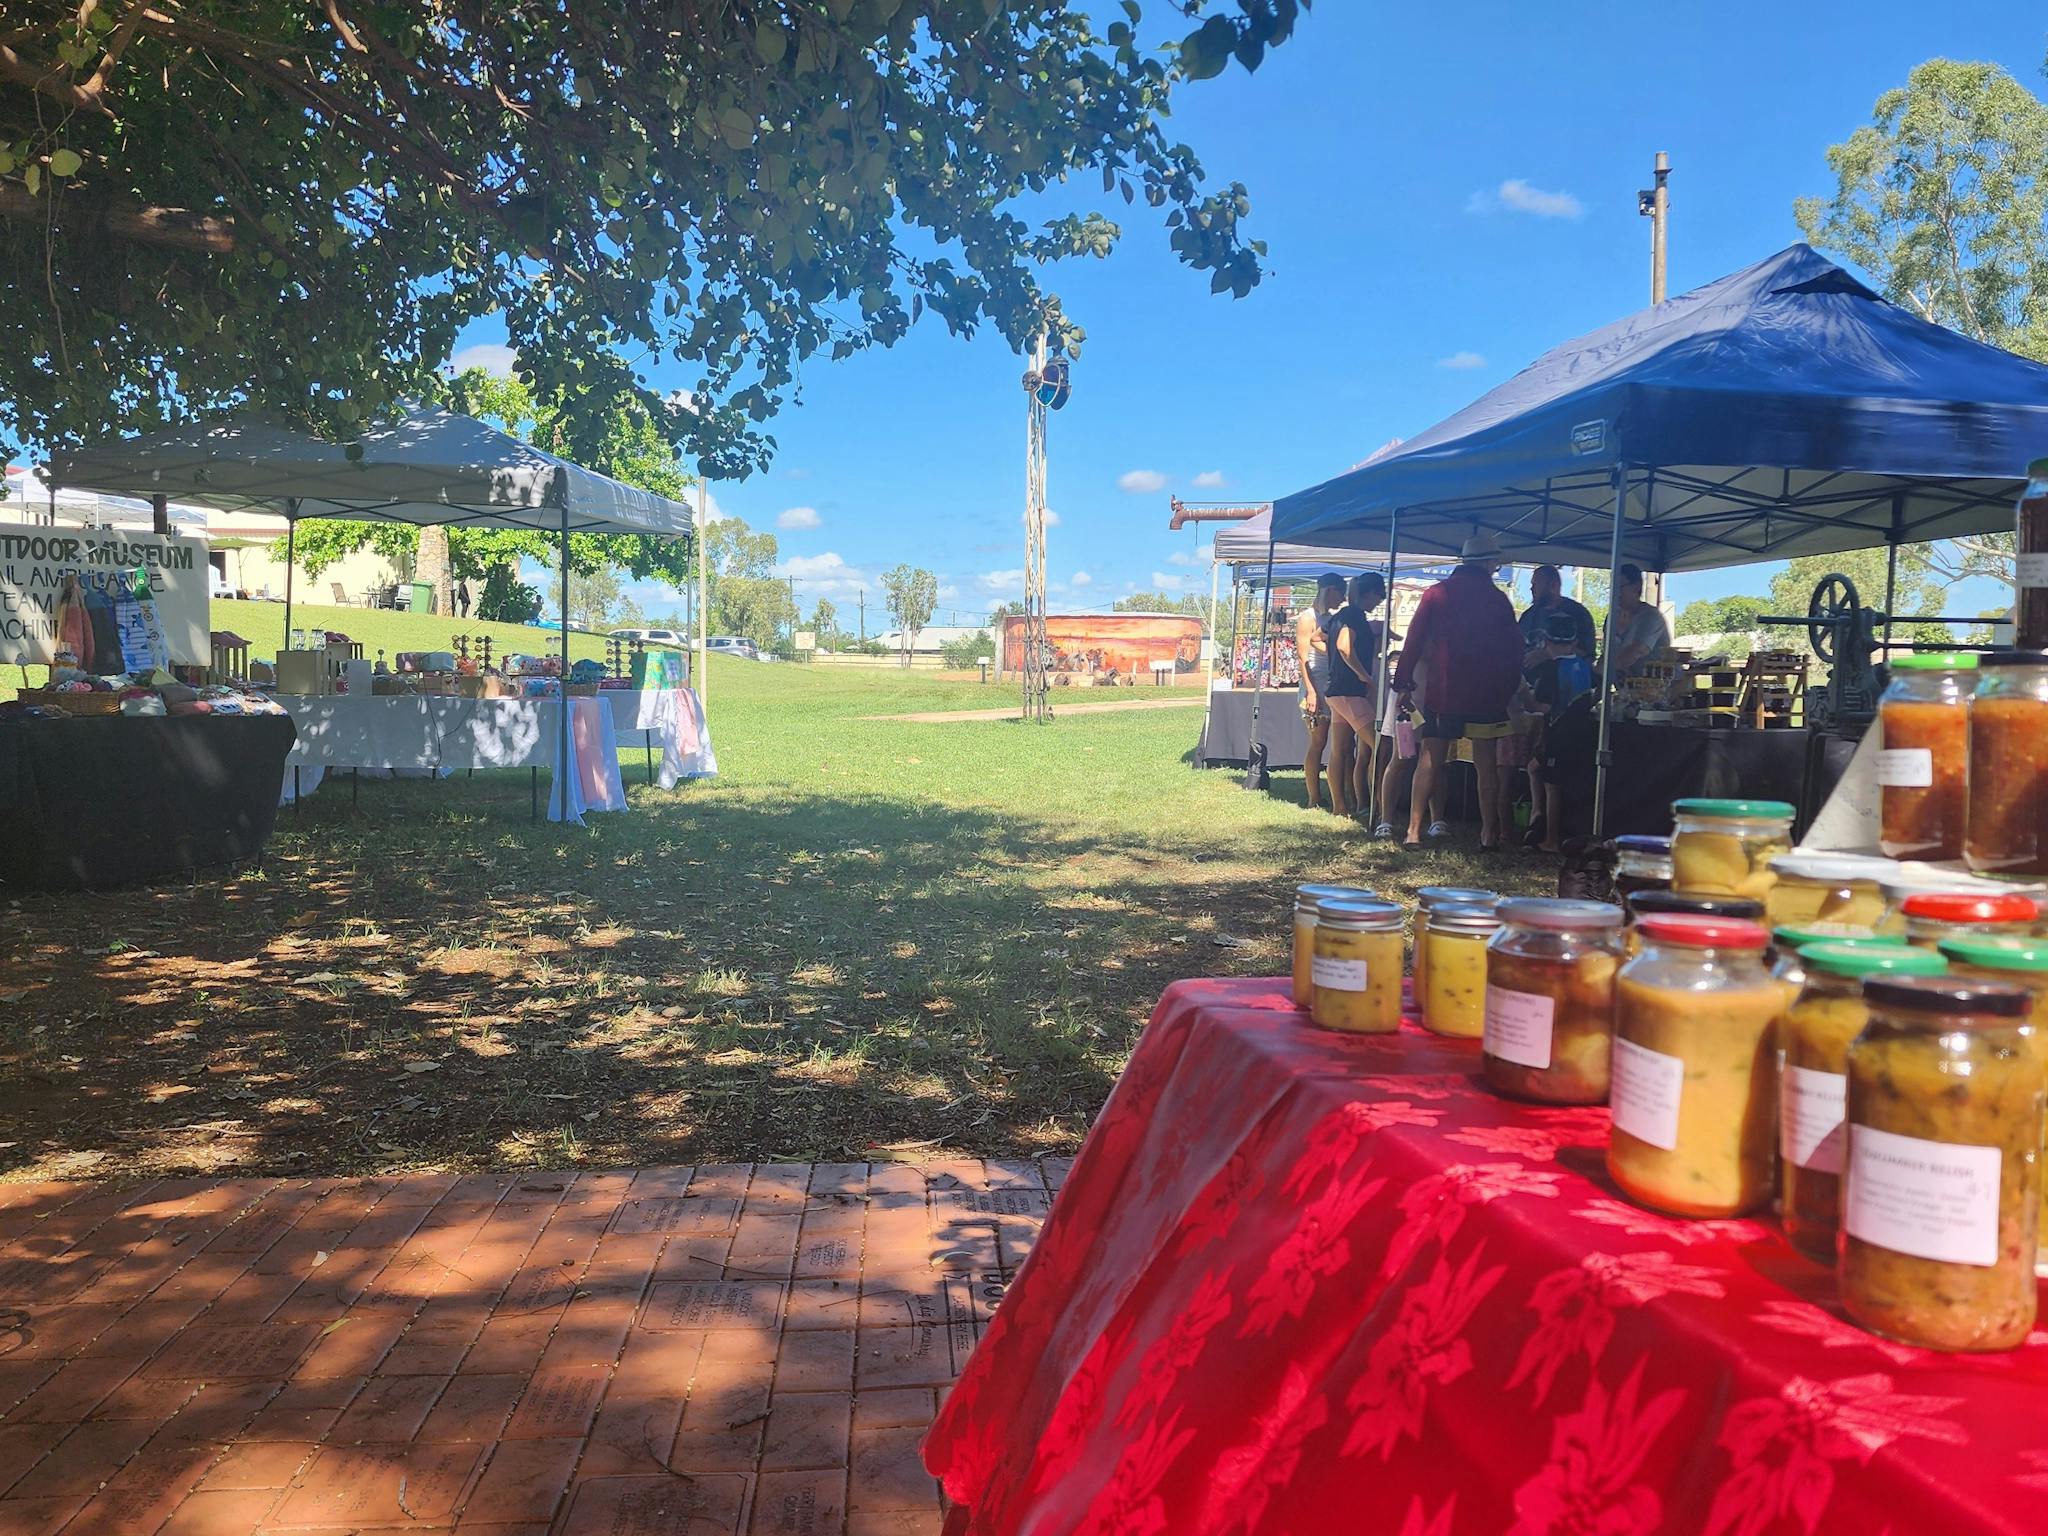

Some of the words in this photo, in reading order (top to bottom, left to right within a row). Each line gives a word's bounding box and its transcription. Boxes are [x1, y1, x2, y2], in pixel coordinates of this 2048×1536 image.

[0, 535, 81, 562] TDOOR
[86, 540, 193, 570] MUSEUM
[30, 567, 164, 592] AMULANE
